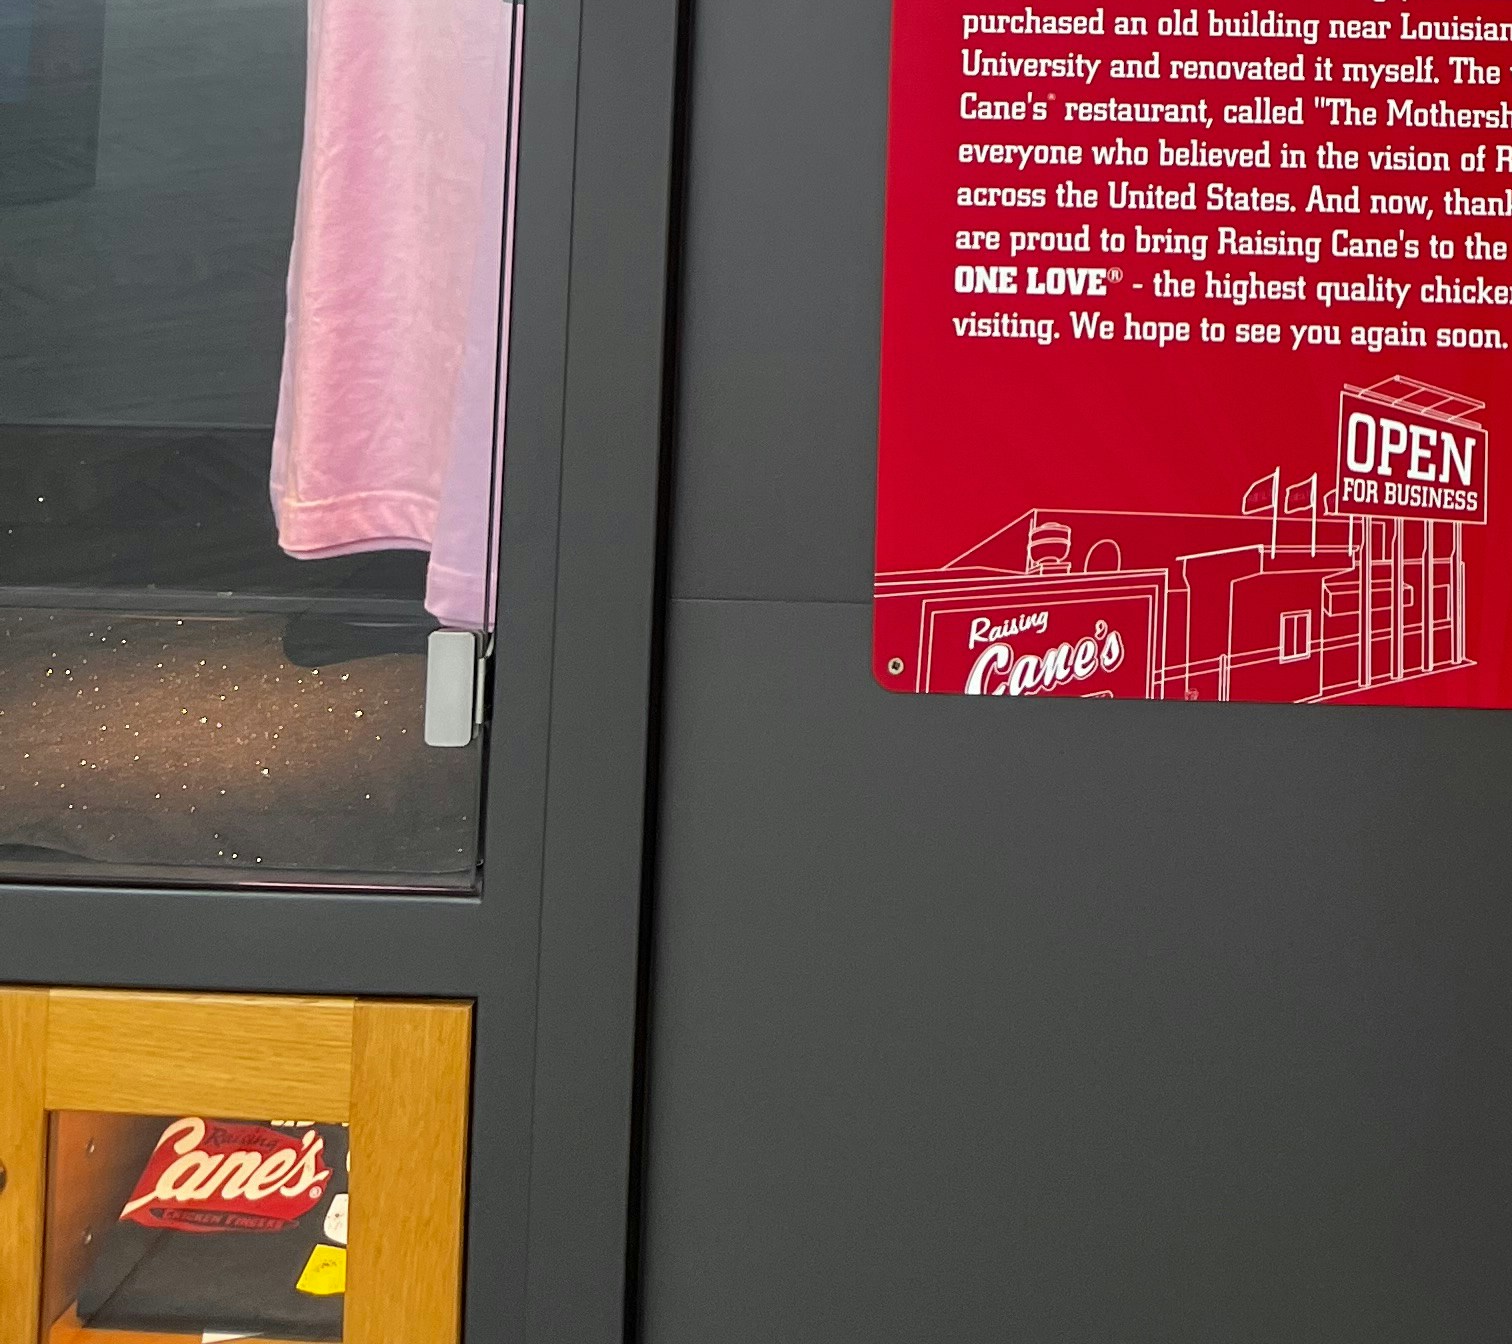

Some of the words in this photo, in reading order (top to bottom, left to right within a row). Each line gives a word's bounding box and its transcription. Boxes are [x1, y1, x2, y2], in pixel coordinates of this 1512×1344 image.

[962, 6, 1105, 40] purchased
[1113, 16, 1149, 36] an
[1157, 8, 1199, 37] old
[1207, 8, 1321, 45] building
[1328, 19, 1392, 40] near
[961, 48, 1102, 85] University
[1109, 51, 1161, 79] and
[1169, 53, 1306, 81] renovated
[1313, 56, 1334, 82] it
[1341, 55, 1440, 90] myself.
[1448, 56, 1501, 85] The
[958, 143, 1083, 171] everyone
[1090, 137, 1149, 166] who
[1158, 138, 1272, 169] believed
[1279, 142, 1307, 169] in
[1316, 141, 1359, 170] the
[1367, 144, 1451, 172] vision
[1460, 144, 1487, 173] of
[1347, 412, 1477, 487] OPEN
[1342, 477, 1379, 504] FOR
[1384, 482, 1478, 511] BUSINESS
[969, 611, 1050, 649] Raising
[964, 620, 1126, 696] Cane's
